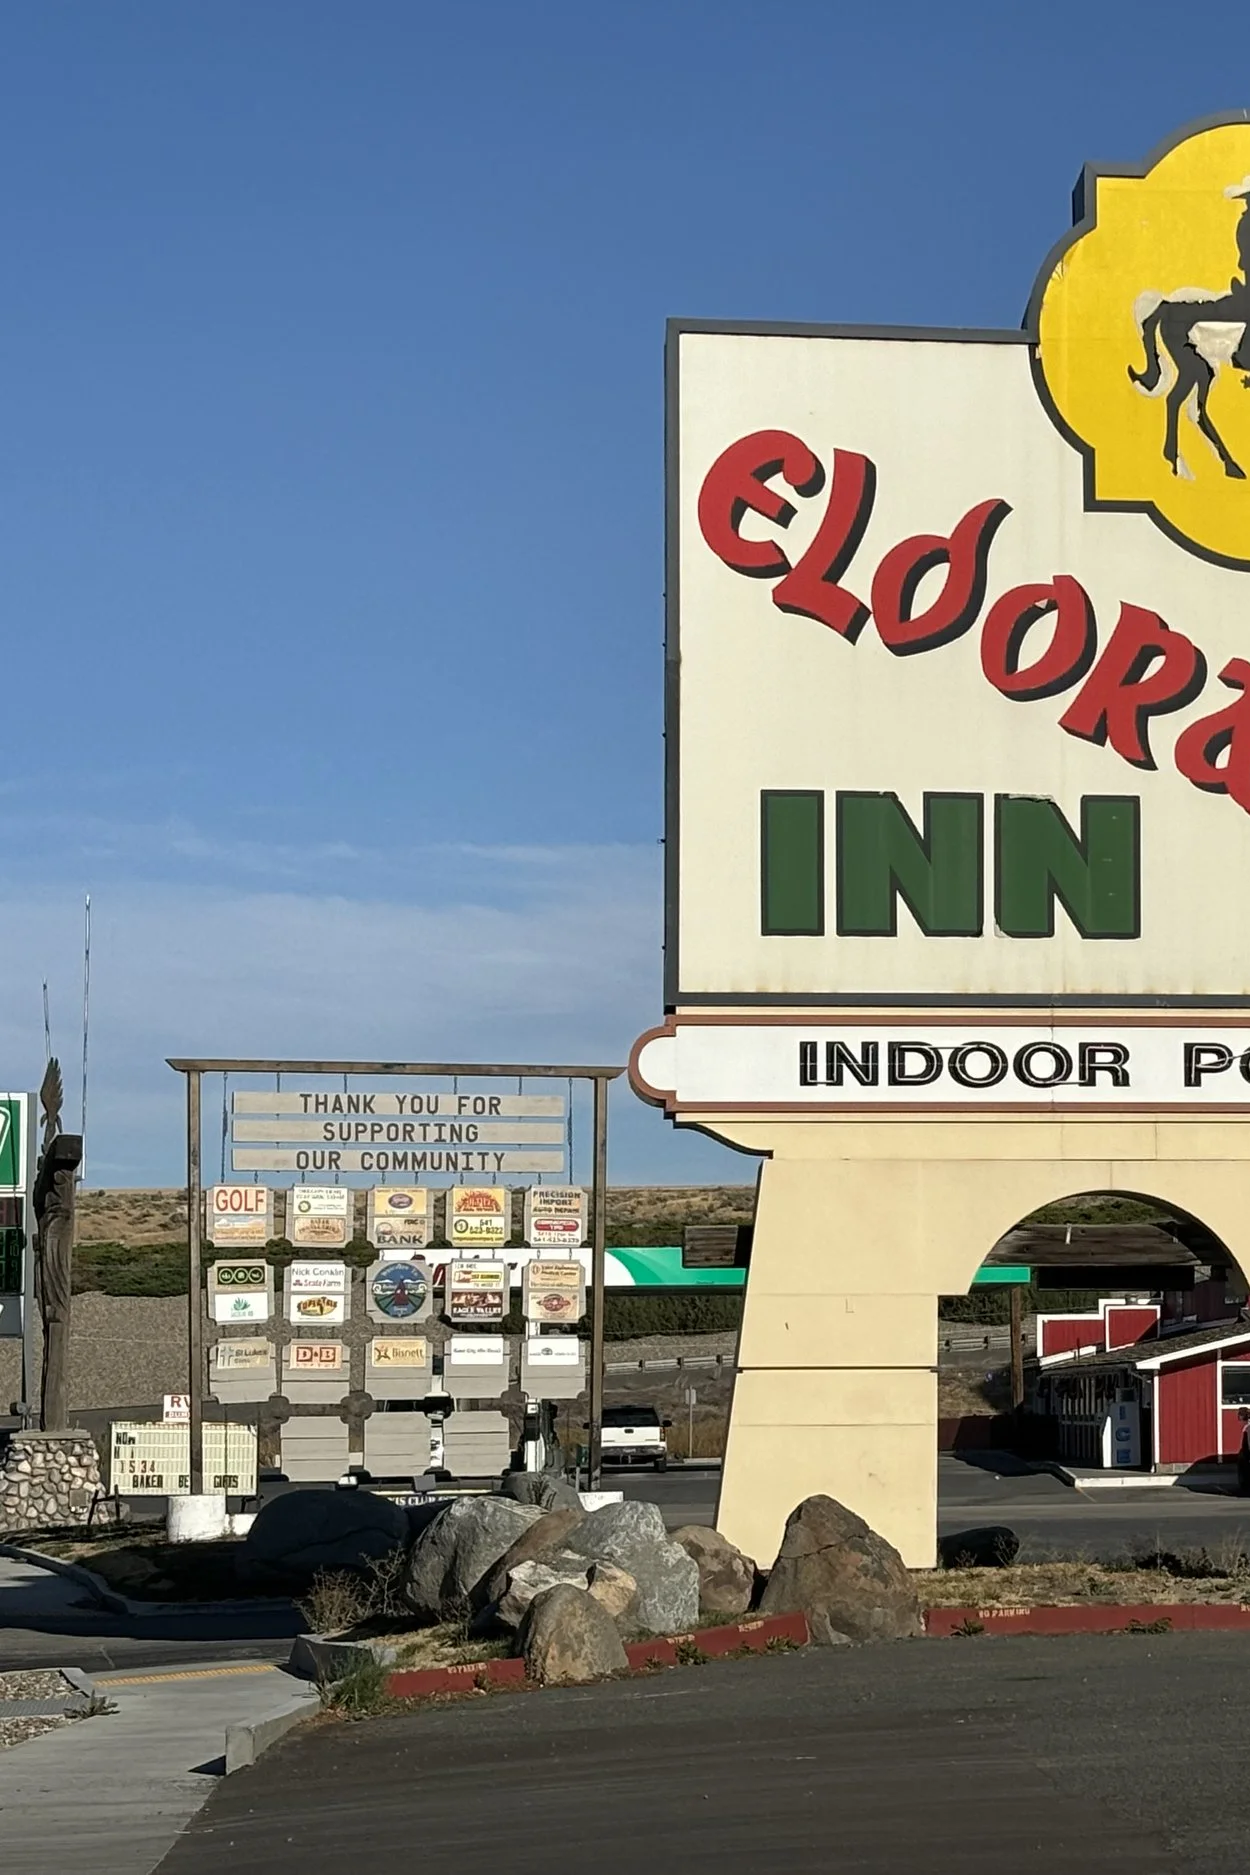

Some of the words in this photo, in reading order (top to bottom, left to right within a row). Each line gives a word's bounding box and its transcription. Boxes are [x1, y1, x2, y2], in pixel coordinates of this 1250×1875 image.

[761, 790, 1140, 939] INN
[799, 1041, 1130, 1088] INDOOR
[300, 1093, 376, 1115] THANK
[395, 1095, 440, 1116] YOU
[457, 1096, 502, 1116] FOR
[323, 1122, 479, 1143] SUPPORTING
[296, 1151, 342, 1171] OUR
[360, 1151, 506, 1172] COMMUNITY
[216, 1189, 265, 1212] GOLF
[533, 1191, 581, 1199] PRECISION
[377, 1235, 424, 1245] BANK
[292, 1267, 310, 1276] Nick
[313, 1267, 345, 1276] Conklin
